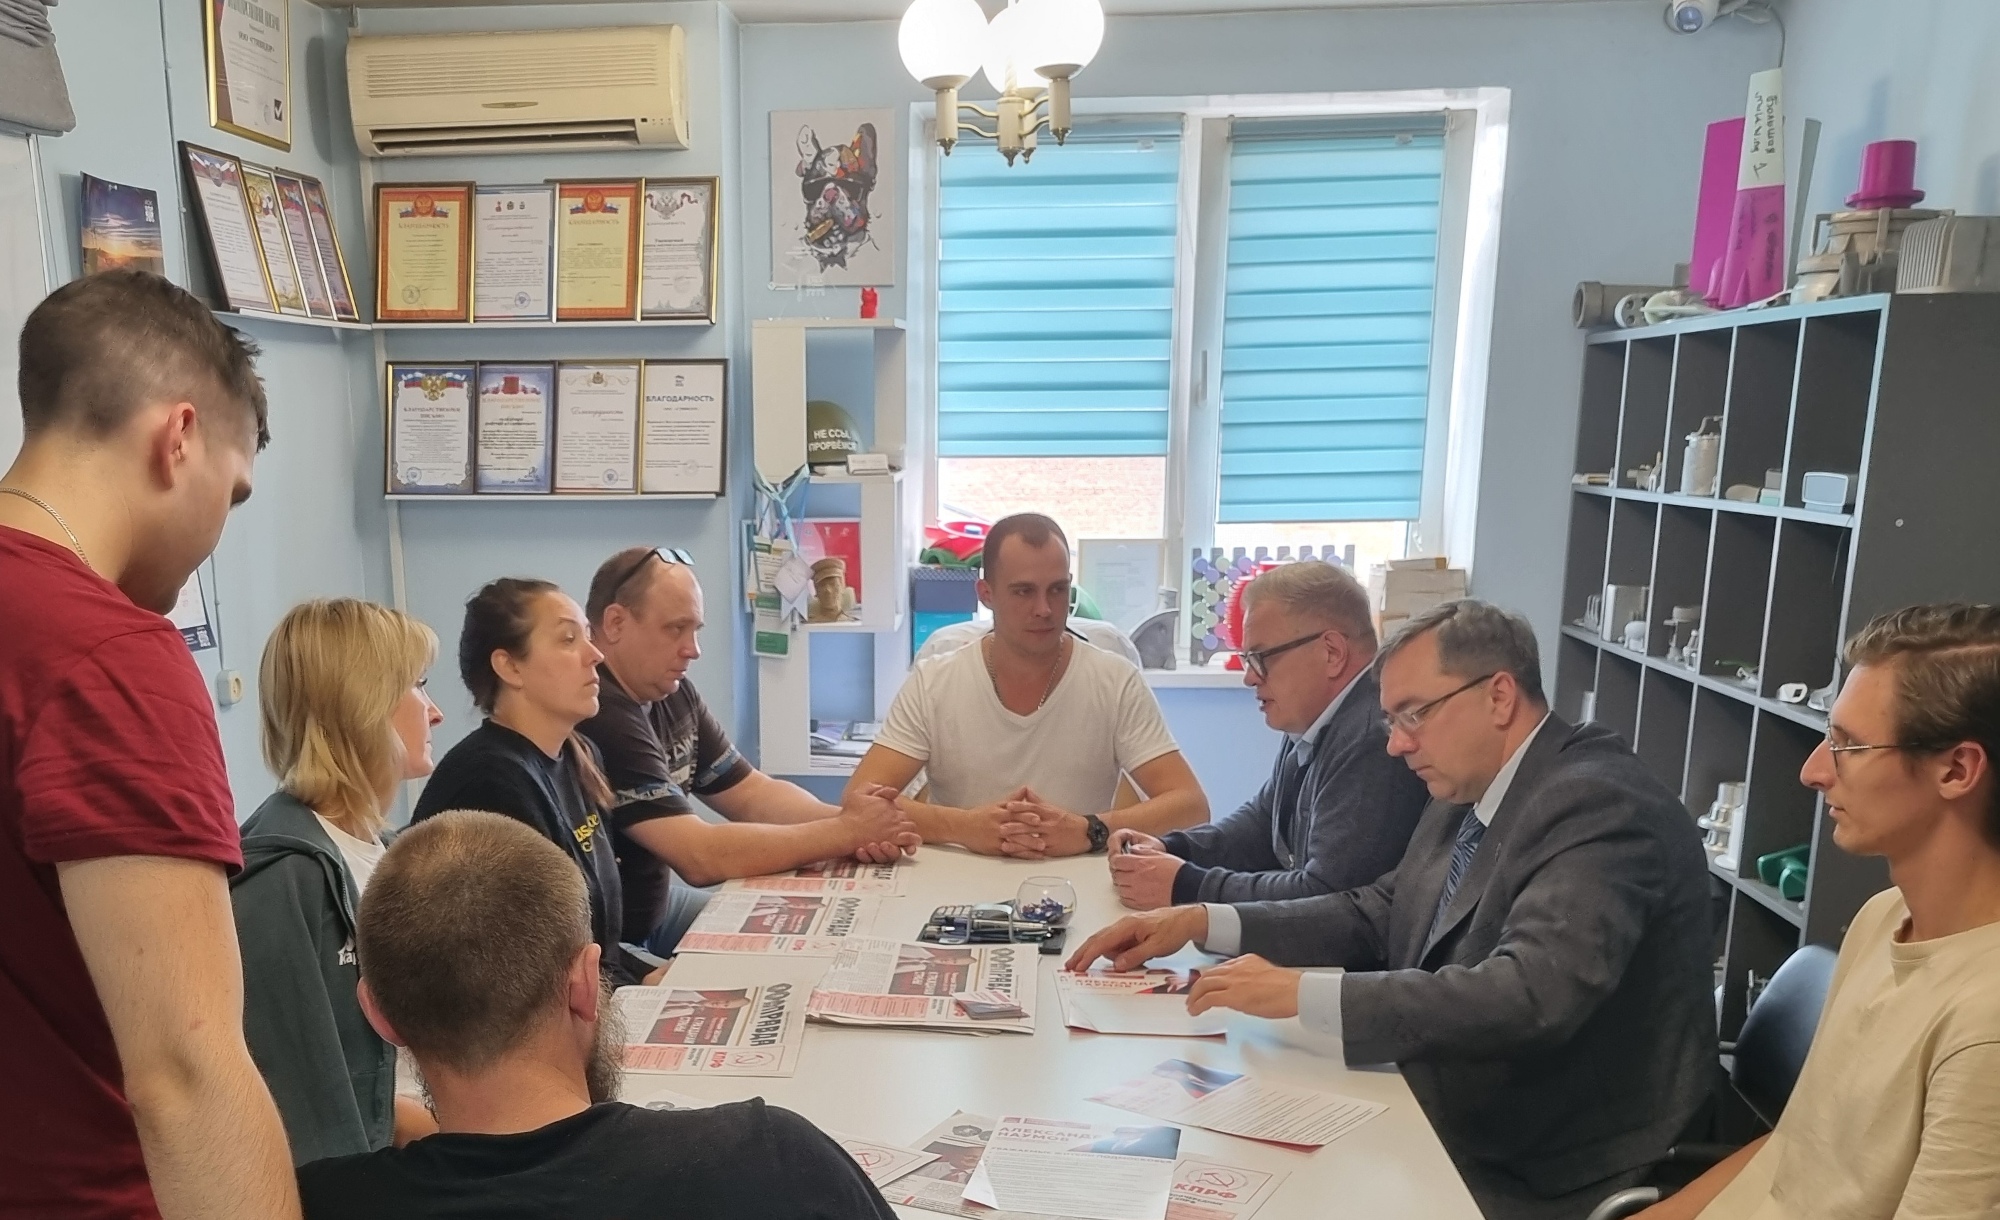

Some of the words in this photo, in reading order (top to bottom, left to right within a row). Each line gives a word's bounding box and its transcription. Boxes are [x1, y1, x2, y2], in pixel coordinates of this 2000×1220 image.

[645, 395, 715, 403] БЛАГОДАРНОСТЬ
[813, 429, 828, 440] НЕ
[998, 1132, 1069, 1142] НАУМОВ
[1174, 1183, 1237, 1199] КПРФ
